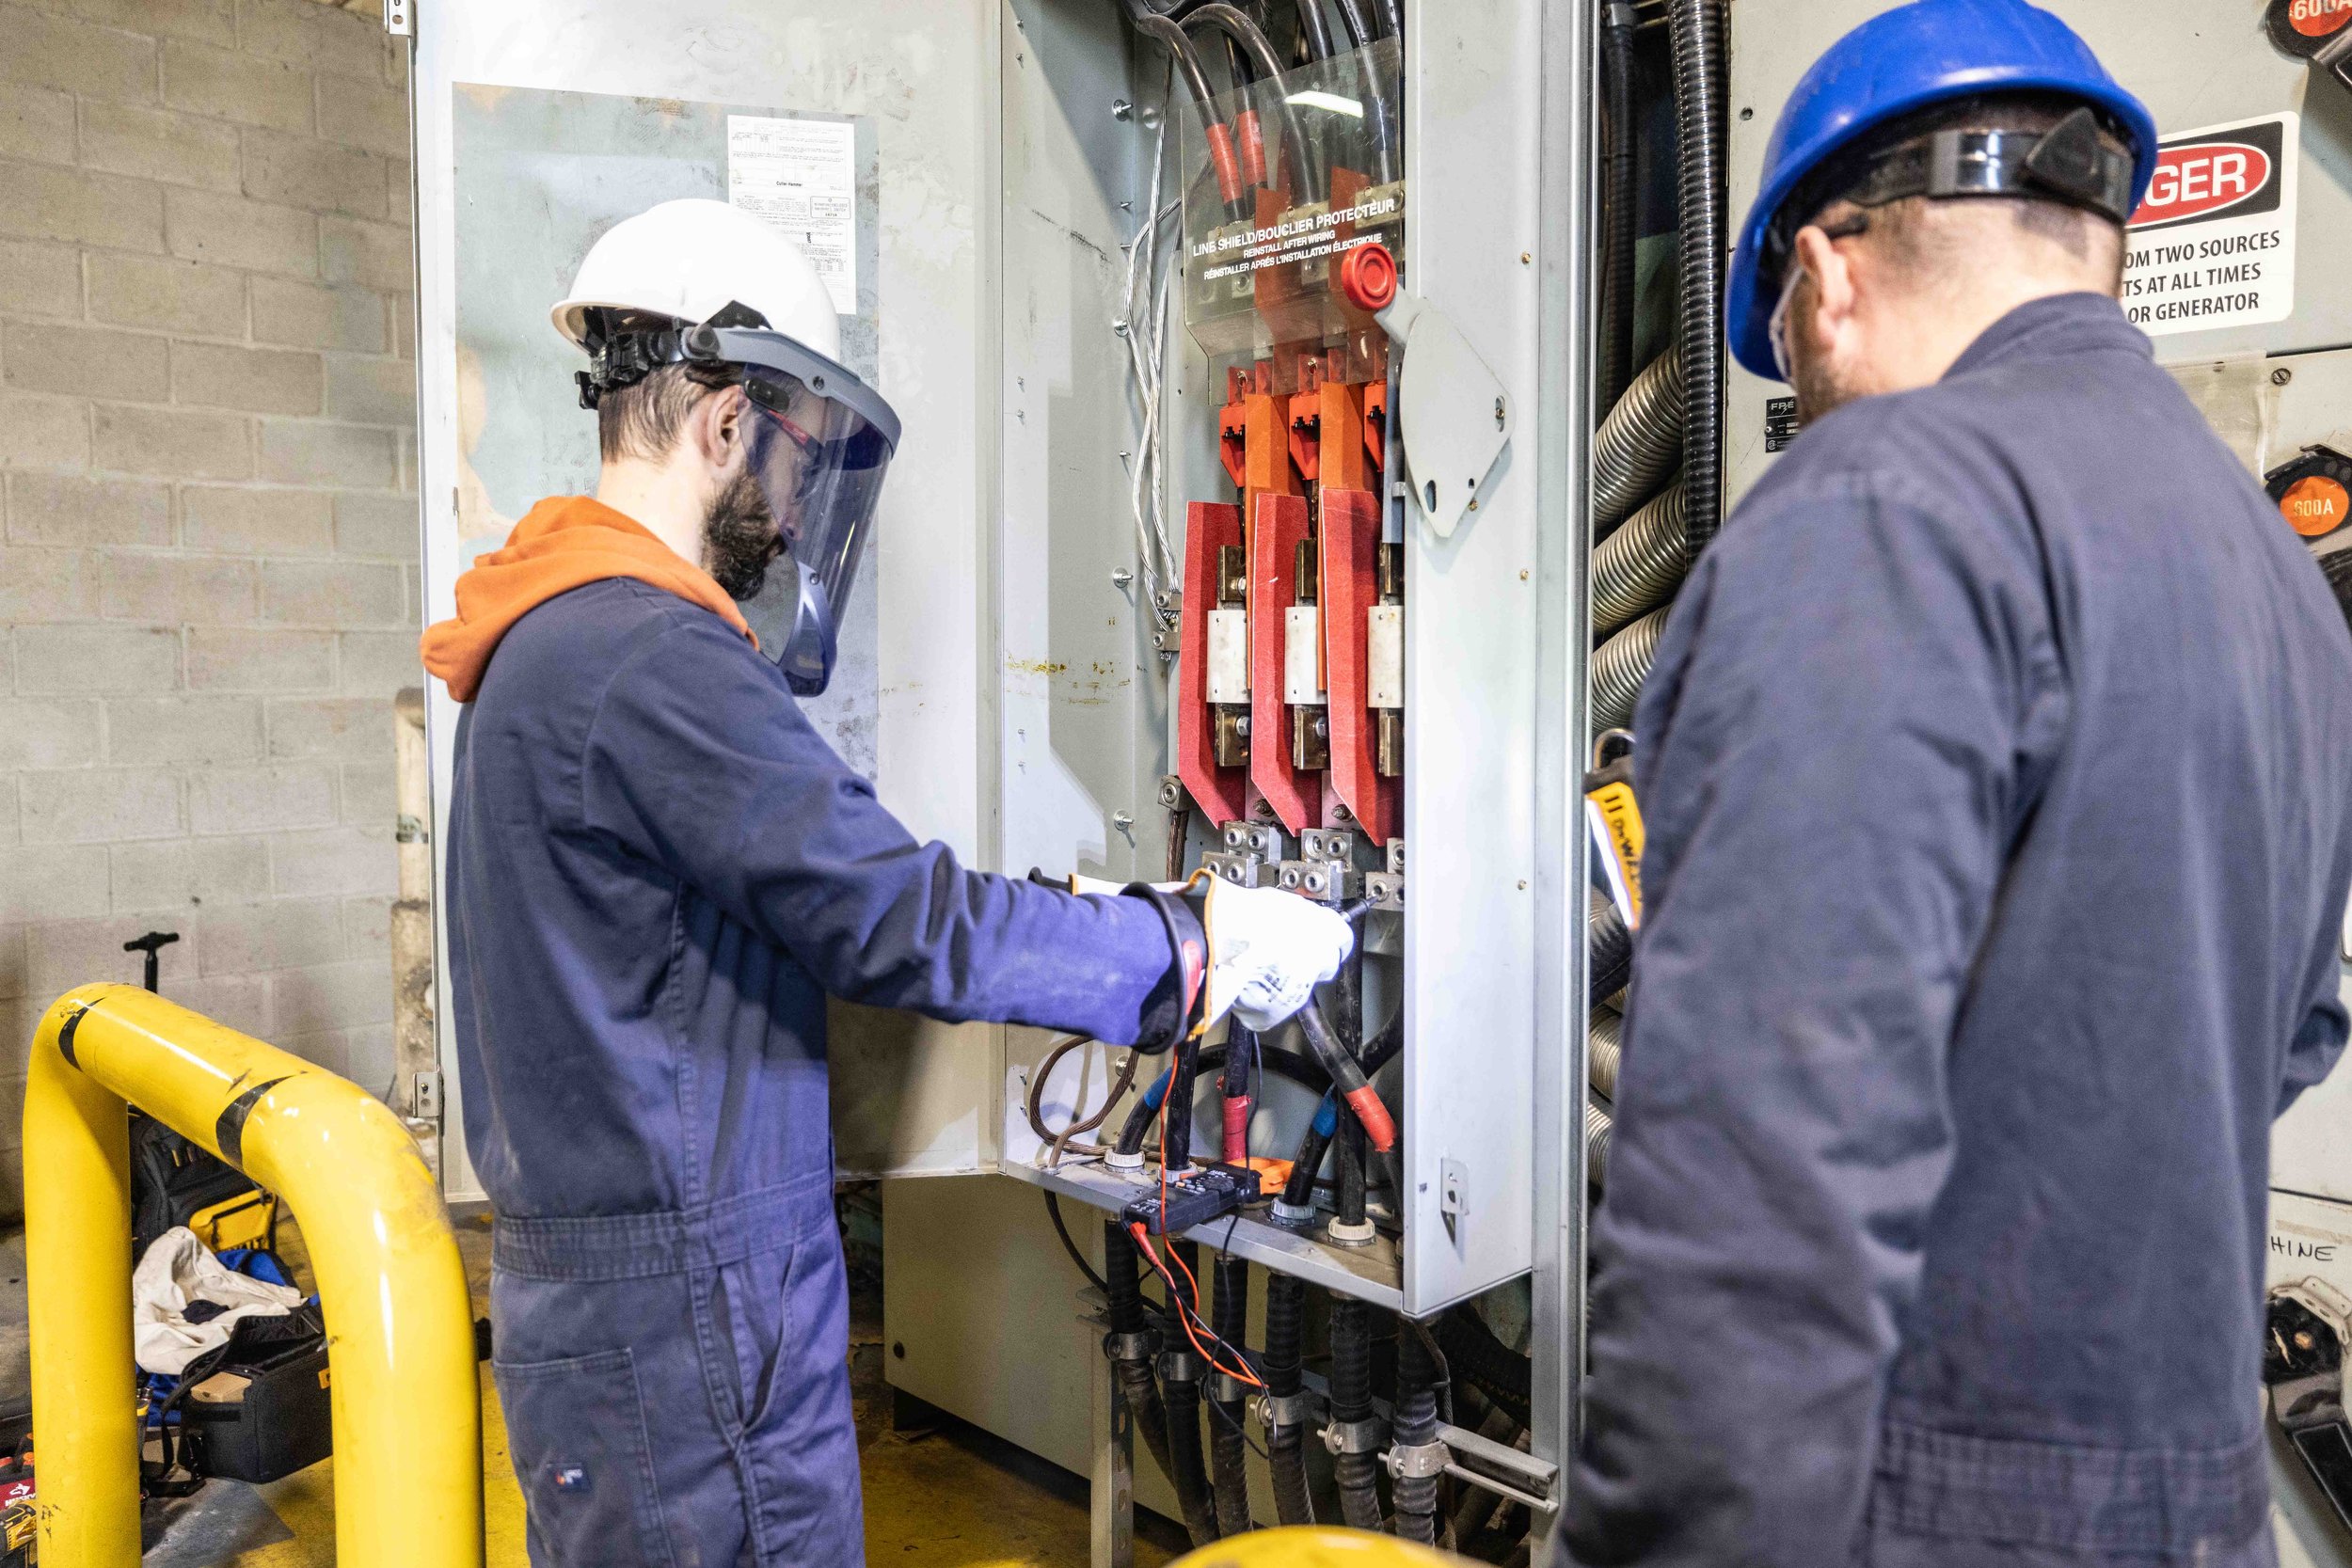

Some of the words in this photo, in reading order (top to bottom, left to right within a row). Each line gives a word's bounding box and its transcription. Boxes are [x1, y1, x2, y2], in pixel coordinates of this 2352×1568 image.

[2136, 152, 2247, 209] GER
[1193, 242, 1217, 257] LINE
[1217, 218, 1313, 251] SHIELD/BOUCLIER
[1316, 198, 1395, 229] PROTECTEUR
[1243, 242, 1282, 259] REINSTALL
[1283, 236, 1308, 250] AFTER
[1308, 230, 1336, 245] WIRING
[1203, 262, 1249, 280] RÉINSTALLER
[1276, 244, 1332, 265] L'INSTALLATION
[1332, 232, 1383, 253] ÉLECTRIQUE
[2124, 249, 2151, 269] OM
[2154, 243, 2195, 265] TWO
[2200, 230, 2280, 259] SOURCES
[2122, 278, 2142, 297] TS
[2146, 275, 2168, 294] AT
[2170, 271, 2202, 291] ALL
[2206, 261, 2262, 286] TIMES
[2128, 306, 2151, 325] OR
[2155, 292, 2260, 321] GENERATOR
[1771, 401, 1794, 410] FPE
[2270, 1235, 2337, 1261] HINE
